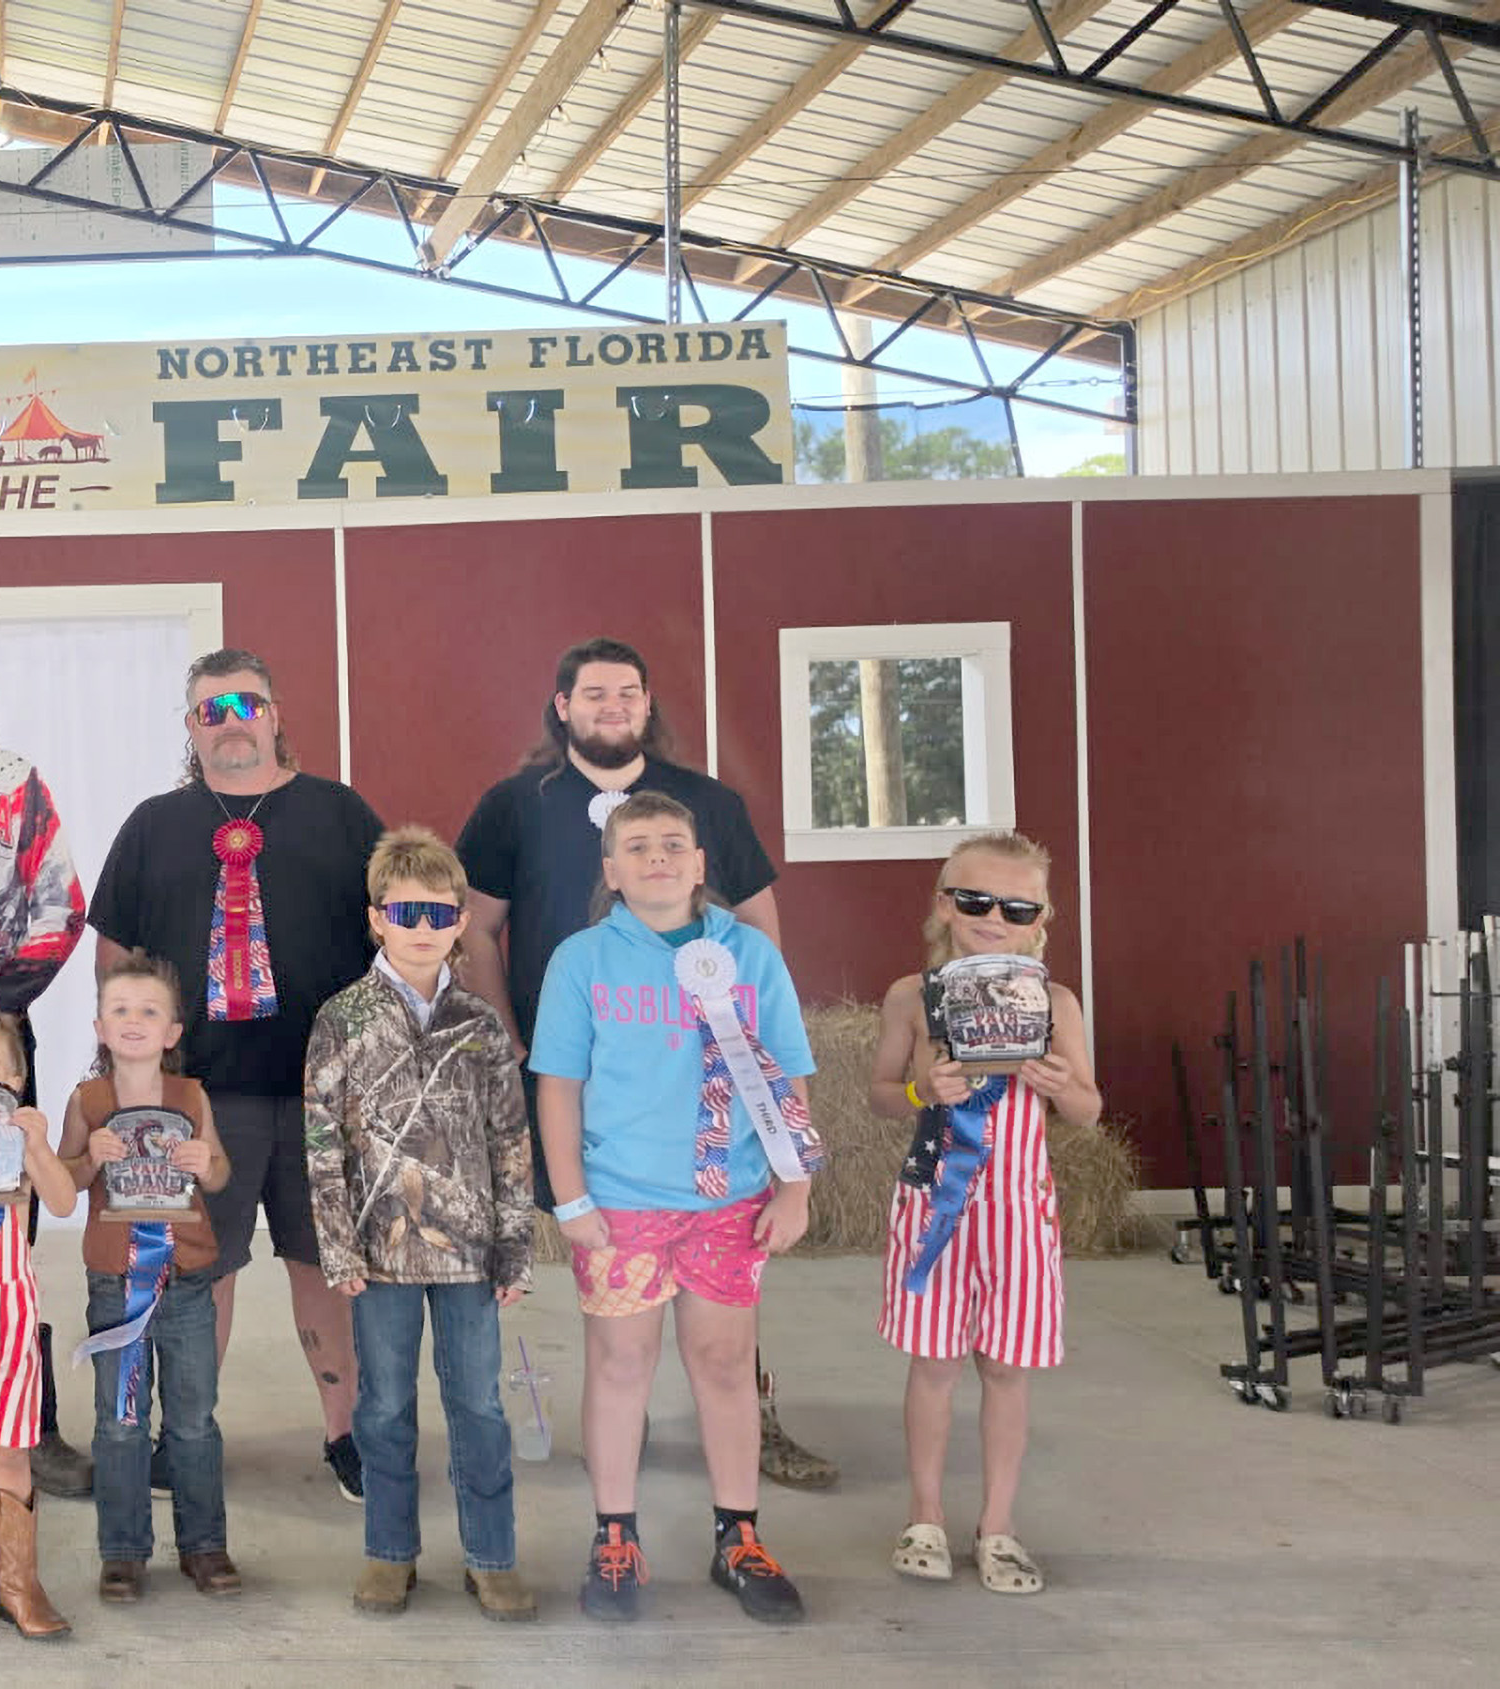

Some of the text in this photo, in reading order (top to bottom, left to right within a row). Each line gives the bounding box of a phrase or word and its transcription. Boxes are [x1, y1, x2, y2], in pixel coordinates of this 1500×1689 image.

[157, 328, 772, 380] NORTHEAST FLORIDA
[152, 383, 783, 504] FAIR
